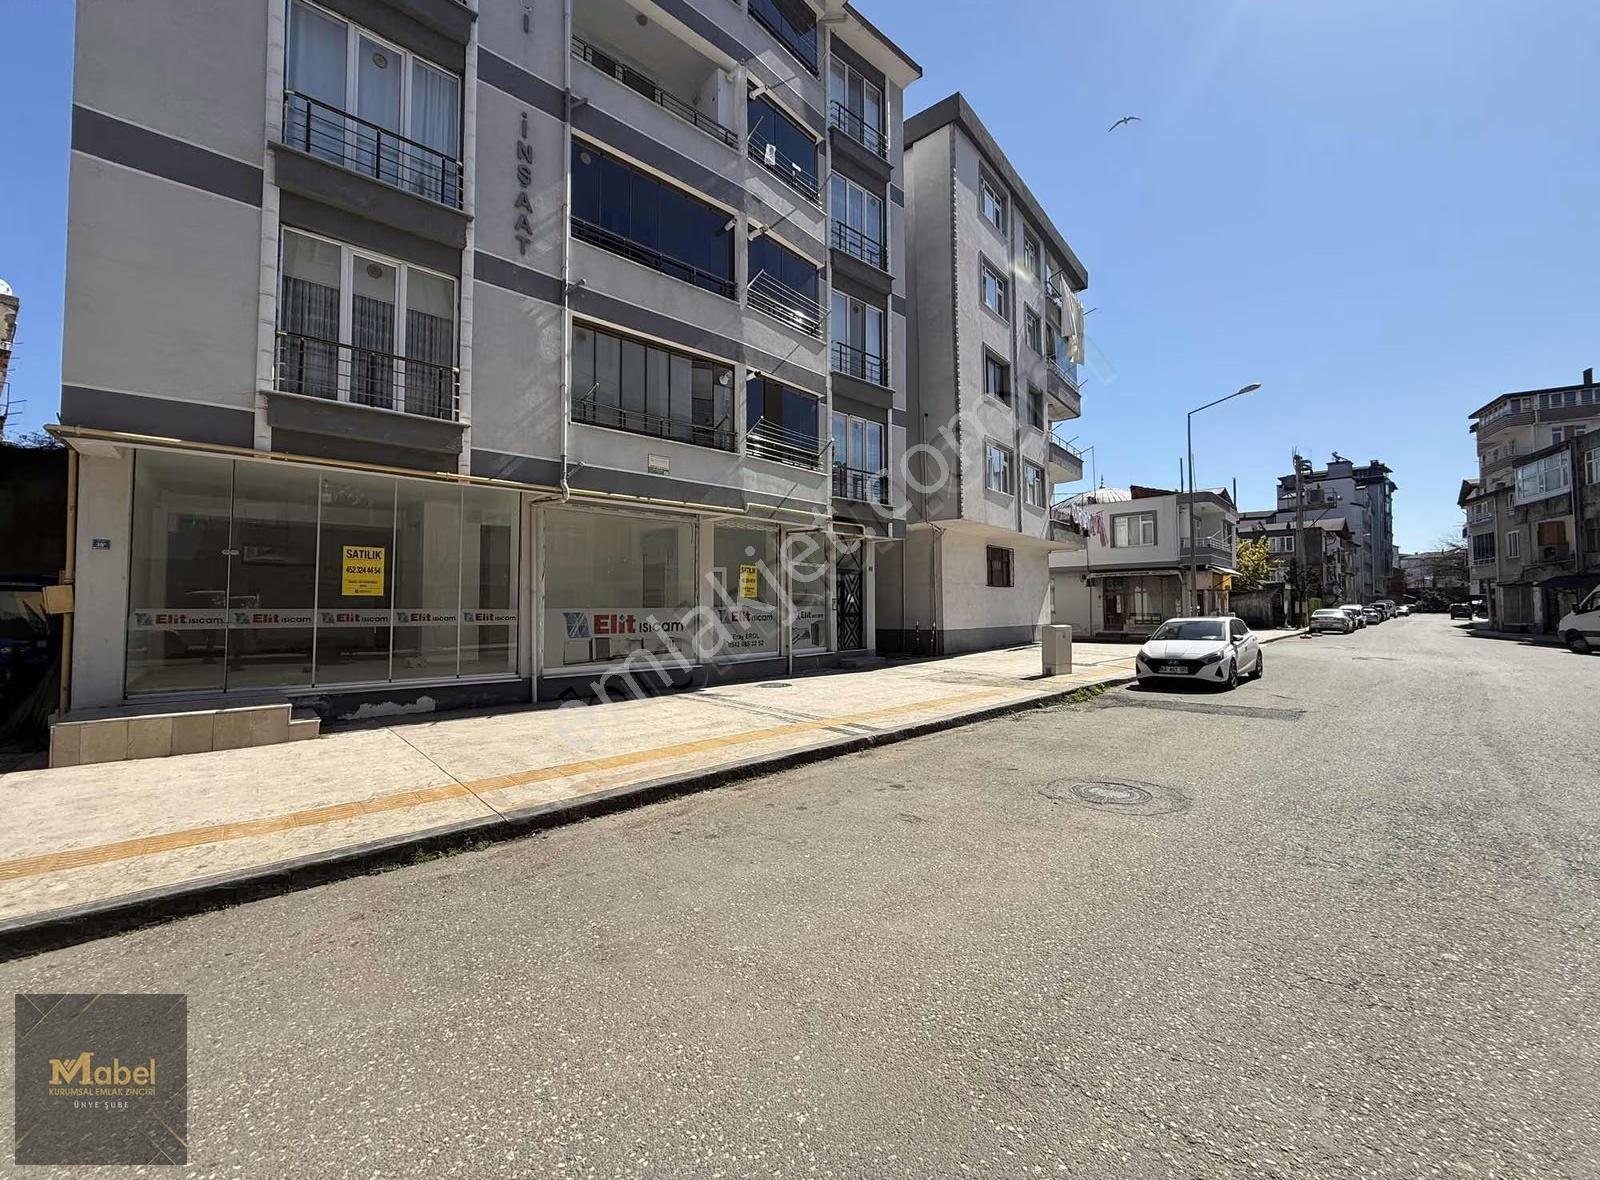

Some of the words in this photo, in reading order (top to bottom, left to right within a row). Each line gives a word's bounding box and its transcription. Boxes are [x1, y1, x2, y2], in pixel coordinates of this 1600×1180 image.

[345, 548, 382, 560] SATILIK
[155, 614, 188, 625] Elit
[252, 613, 280, 624] Elit
[336, 613, 361, 623] Elit
[410, 613, 432, 622] Elit
[475, 613, 494, 622] Elit
[592, 614, 636, 634] Elit
